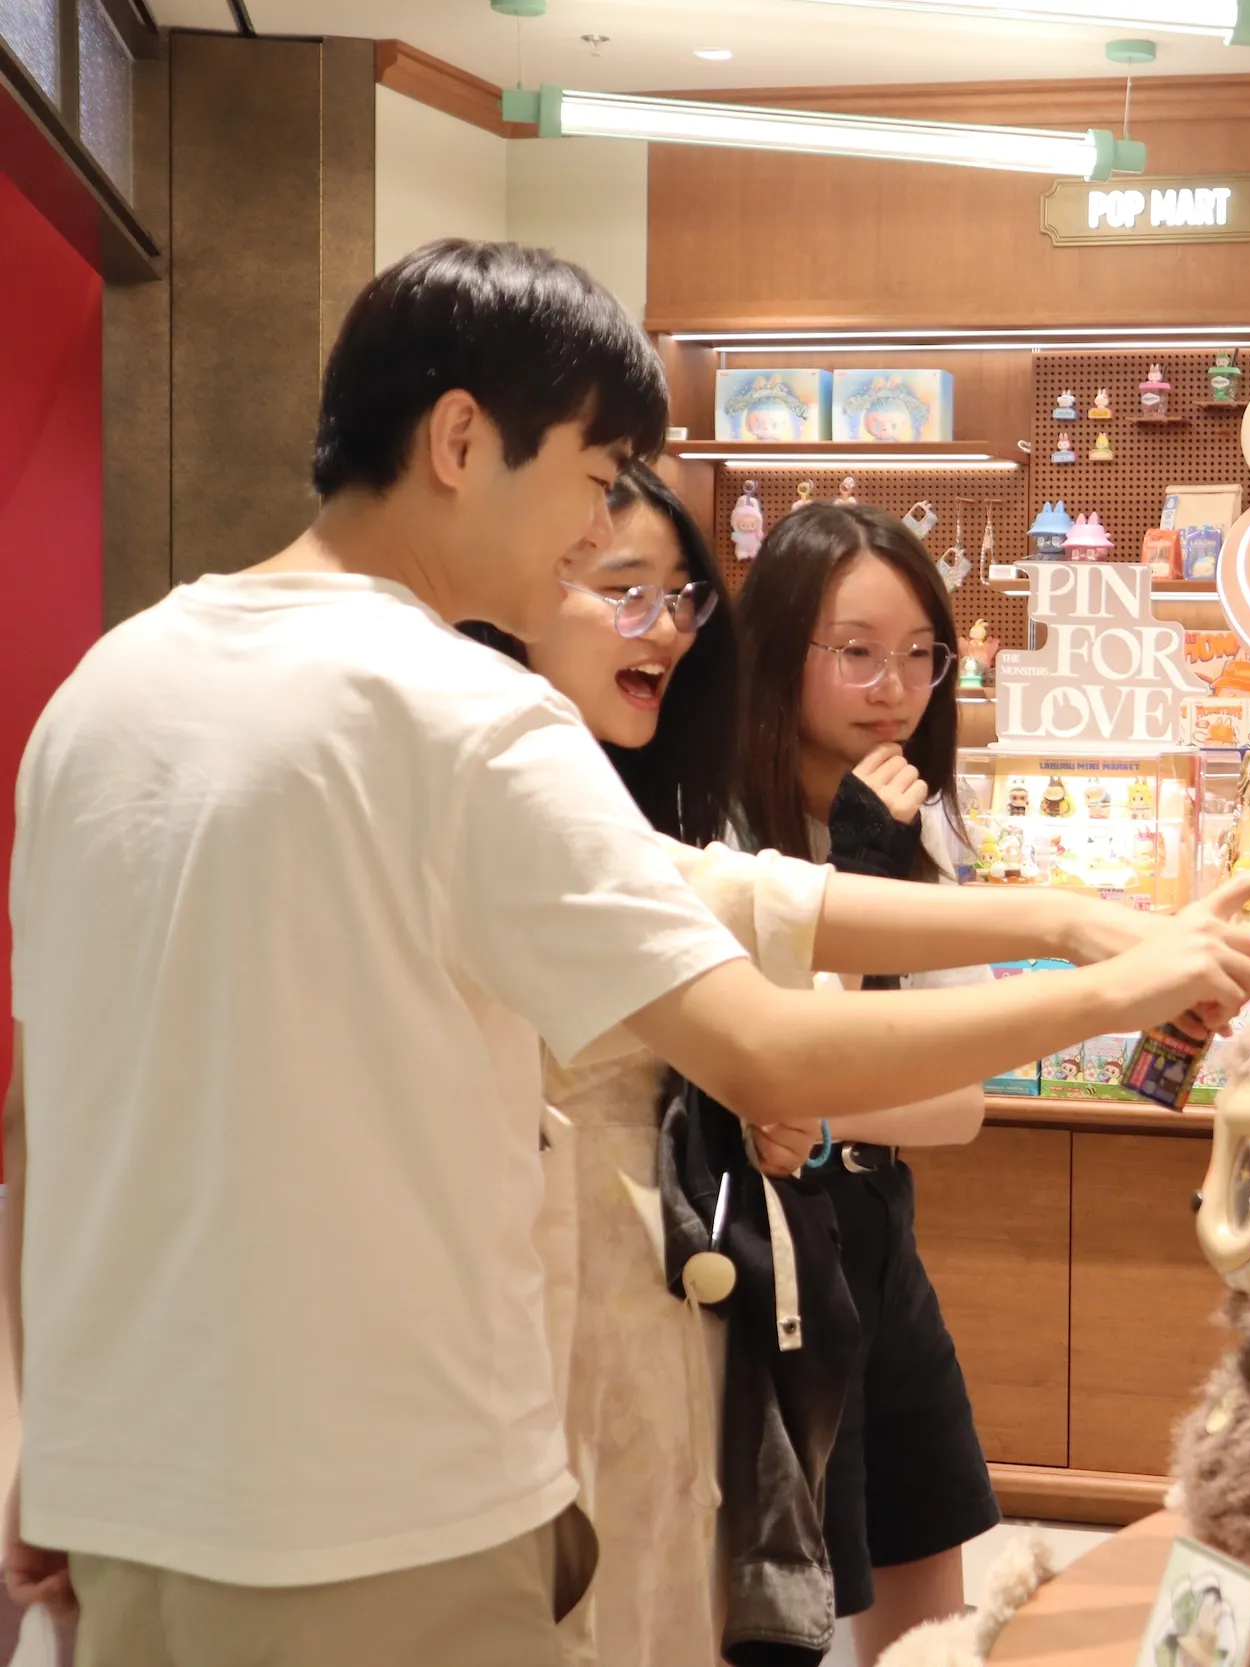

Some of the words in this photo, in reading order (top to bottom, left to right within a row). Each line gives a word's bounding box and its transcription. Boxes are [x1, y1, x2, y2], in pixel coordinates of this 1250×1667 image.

[1088, 190, 1146, 228] POP
[1150, 187, 1232, 227] MART
[1018, 562, 1149, 619] PIN
[1001, 653, 1021, 663] THE
[1001, 665, 1049, 677] MONSTERS
[1050, 623, 1208, 693] FOR
[1001, 682, 1173, 741] LOVE
[1077, 760, 1100, 771] MINI
[1102, 761, 1140, 771] MARKET
